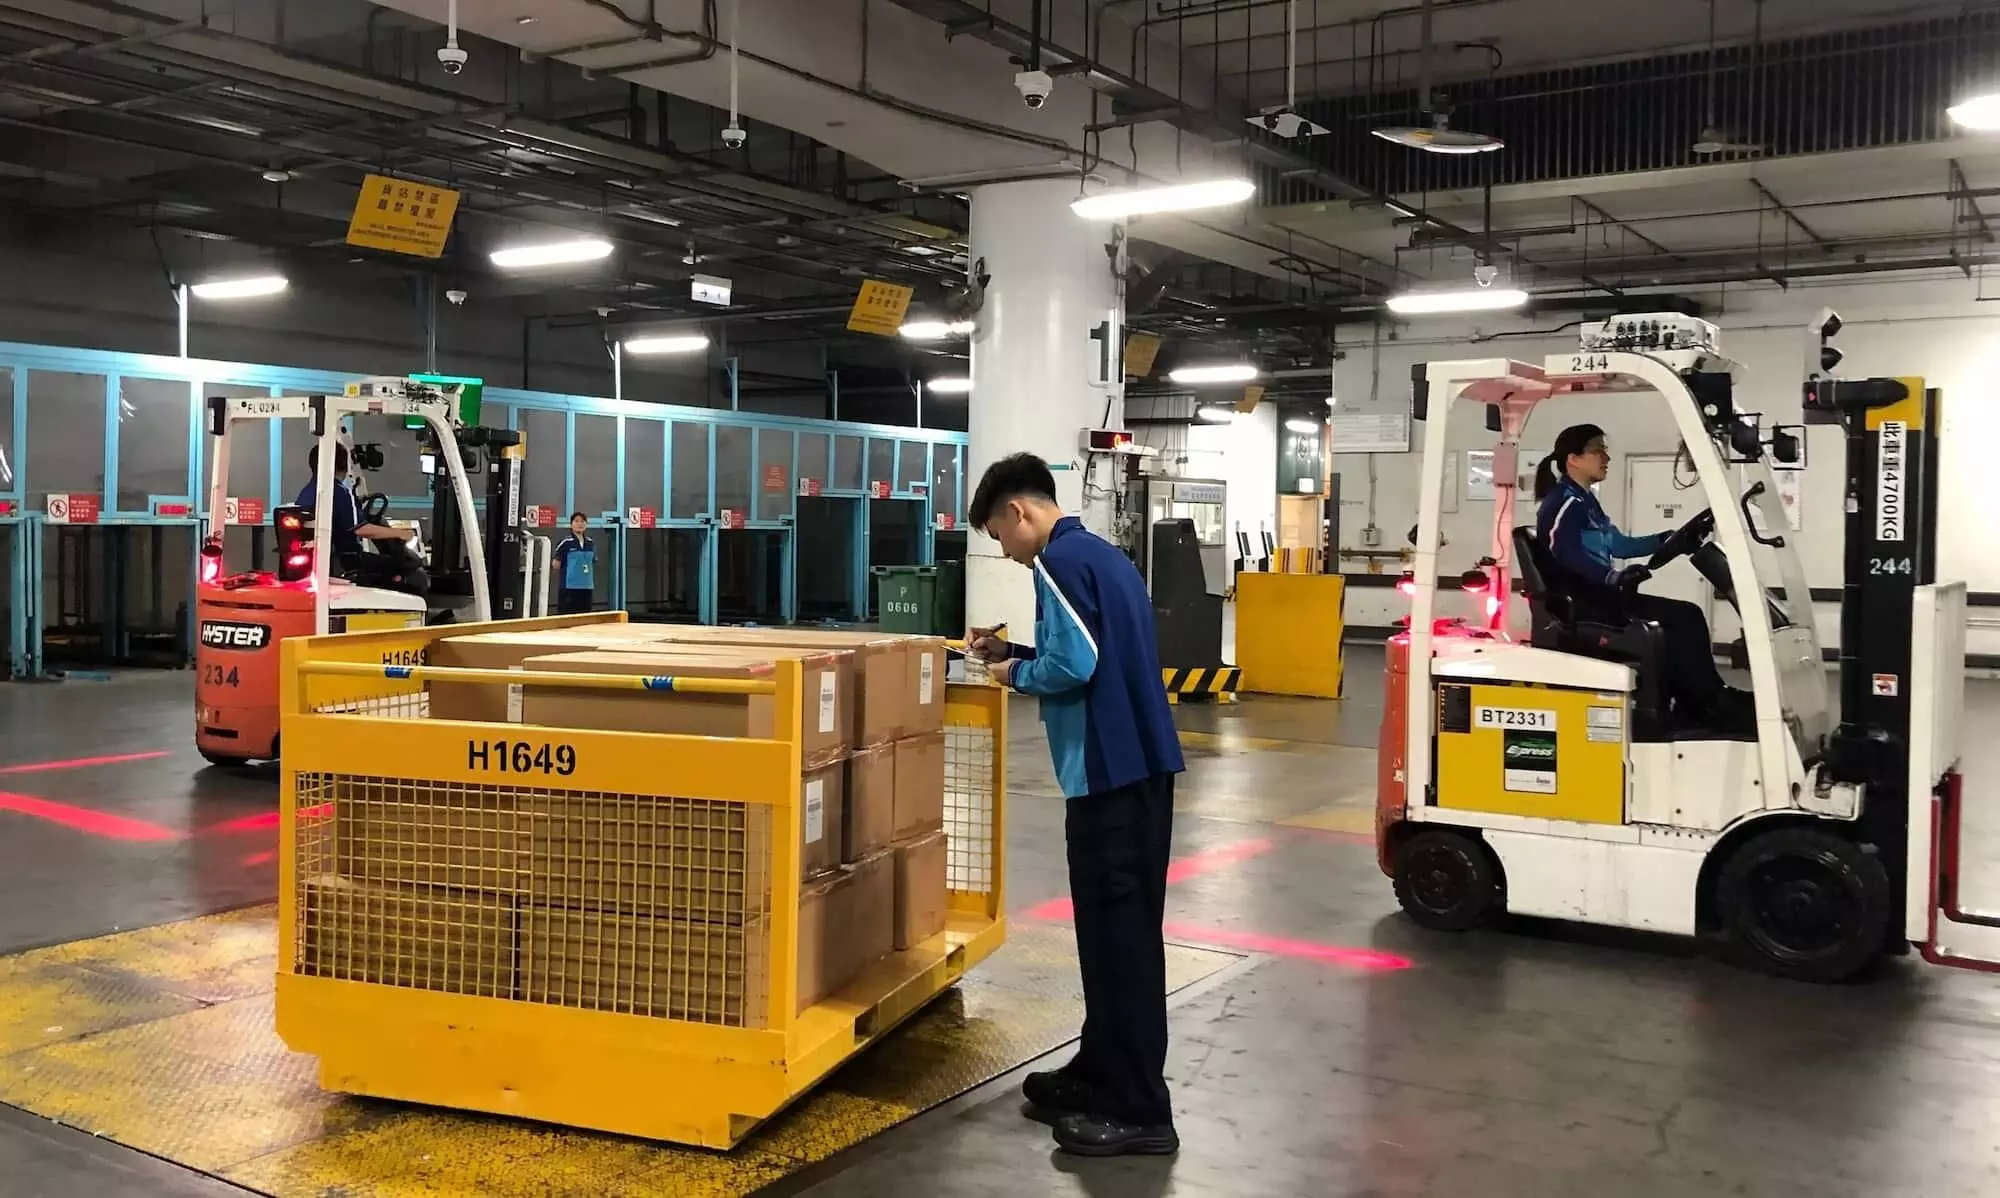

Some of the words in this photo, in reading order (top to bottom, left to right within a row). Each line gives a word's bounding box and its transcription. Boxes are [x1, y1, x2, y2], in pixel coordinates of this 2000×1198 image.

[1572, 355, 1609, 371] 244
[1870, 558, 1912, 575] 244
[887, 601, 918, 614] 0606
[202, 623, 263, 646] HYSTER
[382, 648, 428, 666] H1649
[204, 664, 239, 688] 234
[1482, 709, 1546, 727] BT2331
[468, 739, 577, 776] H1649
